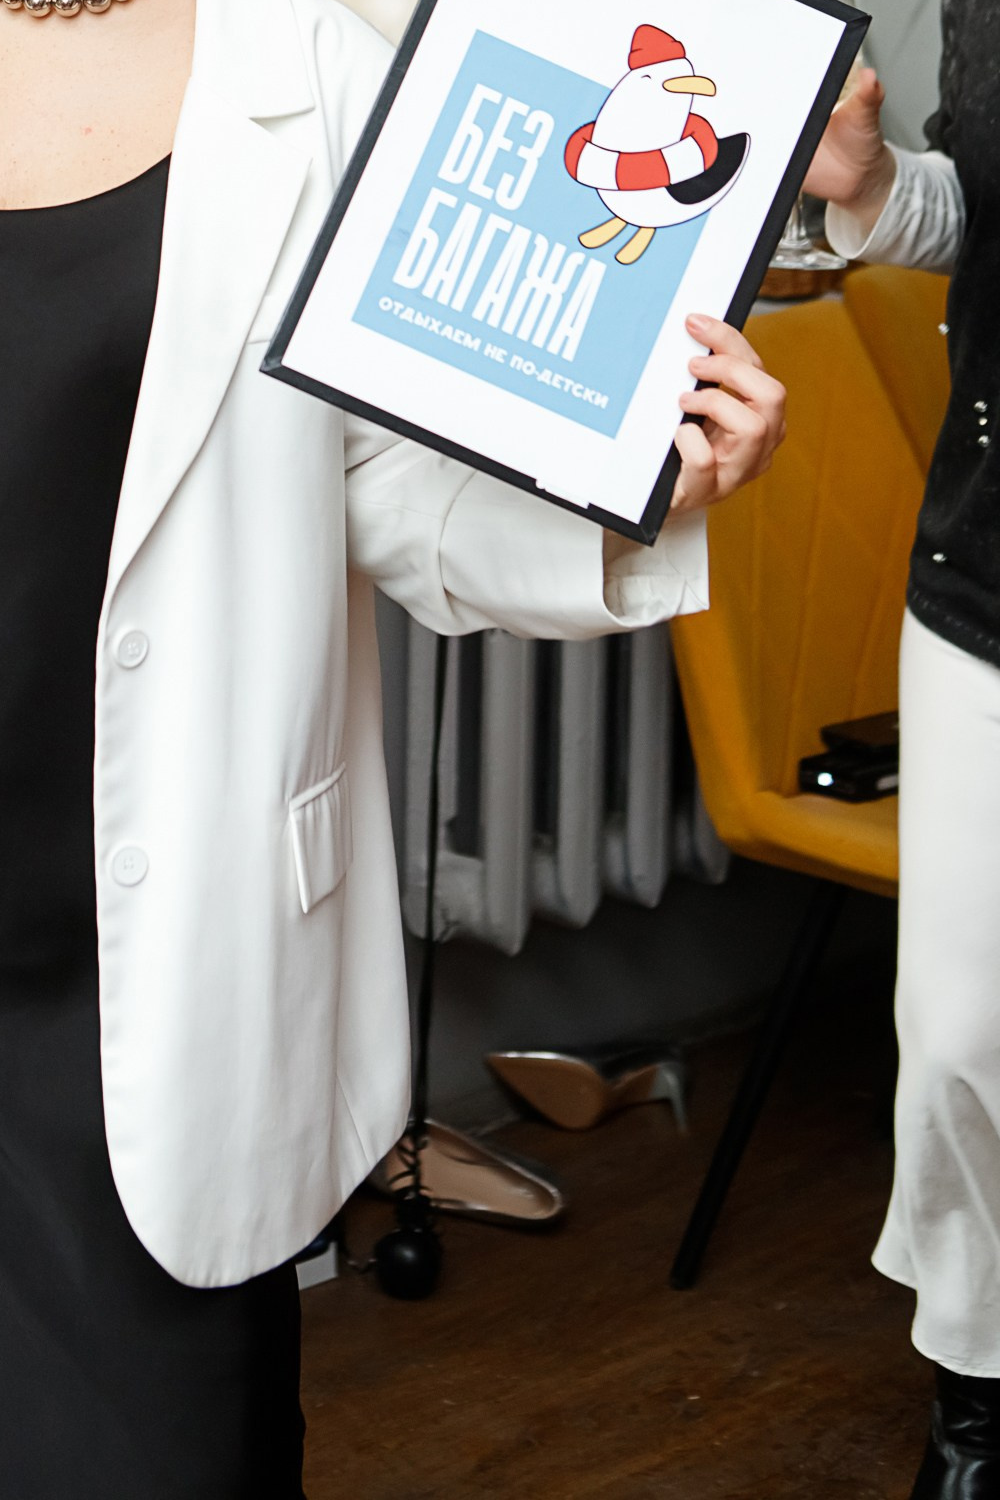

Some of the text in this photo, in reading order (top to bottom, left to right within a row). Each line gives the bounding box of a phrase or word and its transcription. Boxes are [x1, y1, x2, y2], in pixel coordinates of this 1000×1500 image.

[437, 83, 555, 211] БЕЗ
[392, 186, 607, 362] БАГАЖА
[378, 296, 610, 409] ОТДЫХАЕМ НЕ ПО-ДЕТСКИ
